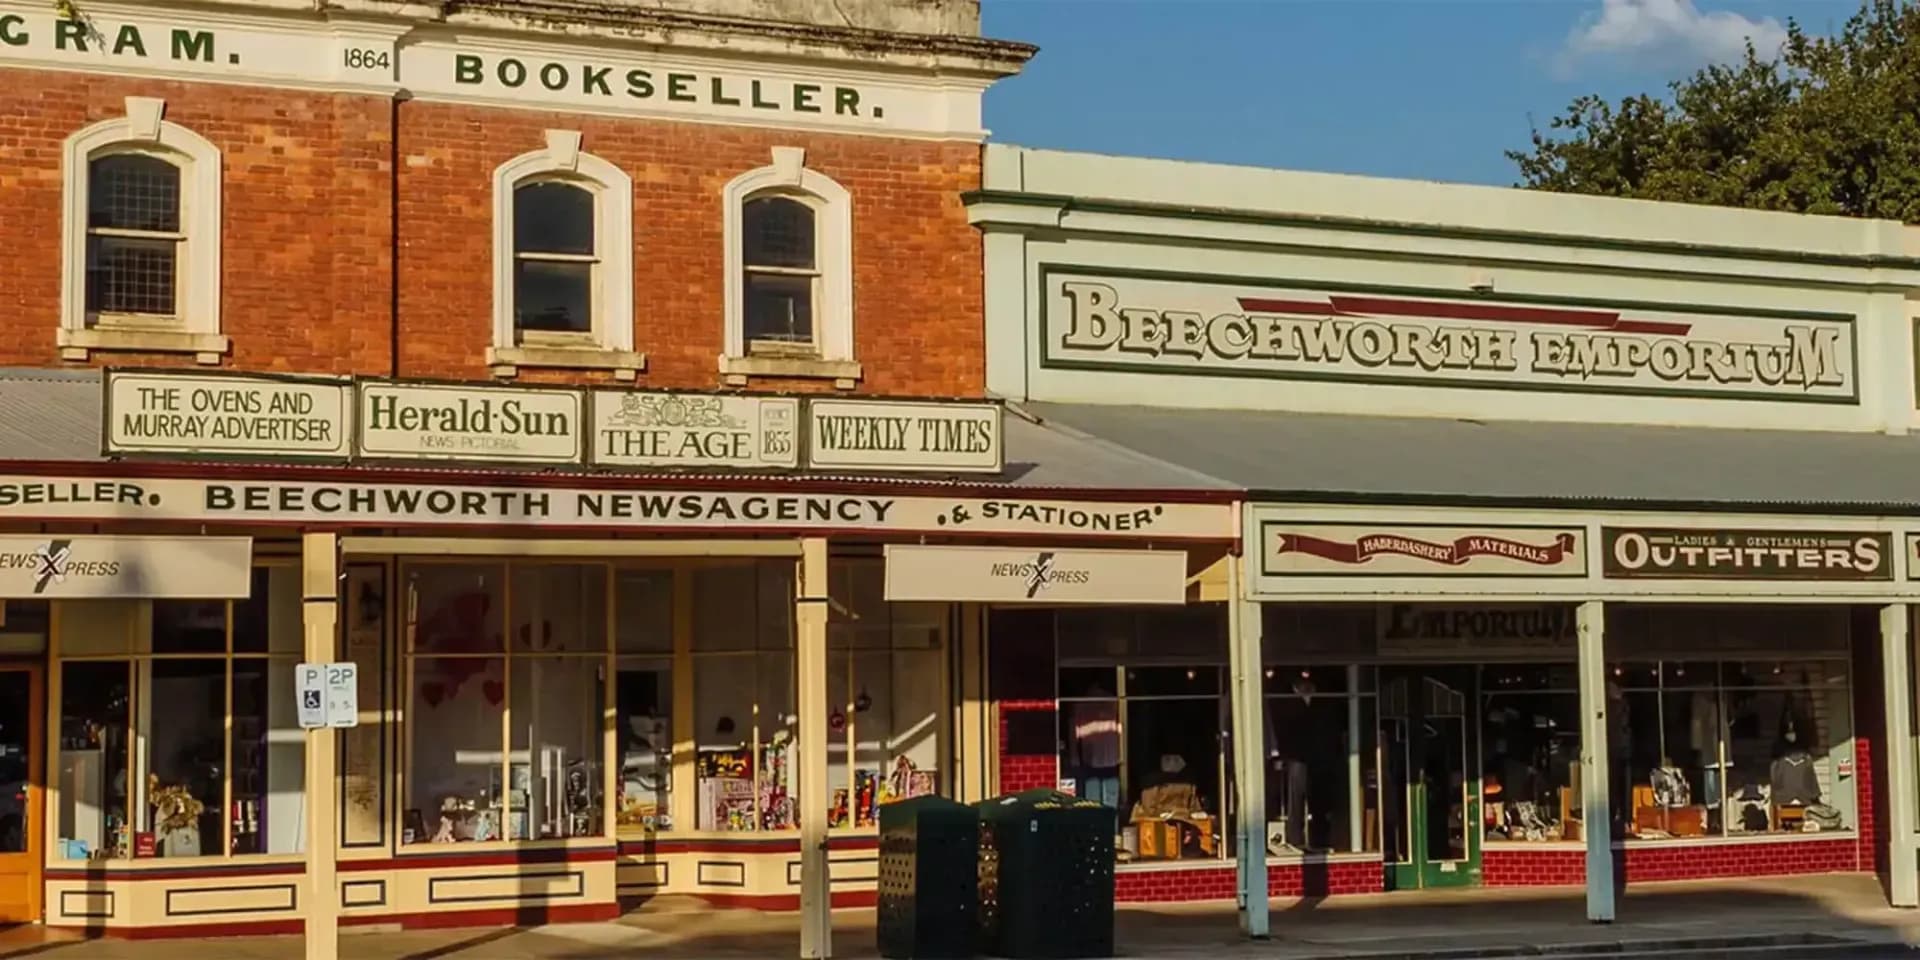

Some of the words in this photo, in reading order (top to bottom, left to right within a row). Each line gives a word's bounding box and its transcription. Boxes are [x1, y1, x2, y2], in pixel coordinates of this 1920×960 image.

[0, 14, 240, 64] GRAM.
[343, 48, 390, 70] 1864
[455, 53, 884, 118] BOOKSELLER.
[1062, 281, 1517, 371] BEECHWORTH
[1531, 325, 1844, 391] EMPORIUM
[137, 387, 181, 412] THE
[191, 388, 262, 414] OVENS
[268, 391, 313, 415] AND
[123, 413, 208, 438] MURRAY
[211, 416, 331, 442] ADVERTISER
[420, 435, 454, 448] NEWS
[816, 415, 911, 451] WEEKLY
[918, 418, 991, 453] TIMES
[601, 430, 671, 457] THE
[679, 431, 752, 459] AGE
[206, 485, 549, 516] BEECHWORTH
[577, 493, 893, 522] NEWSAGENCY
[1363, 538, 1451, 560] HABERDASHERY
[1469, 538, 1549, 562] MATERIALS
[1614, 532, 1881, 572] OUTFITTERS
[1675, 535, 1717, 546] LADIES
[1747, 536, 1828, 547] GENTLEMENS
[306, 669, 318, 685] P
[329, 668, 354, 685] 2P
